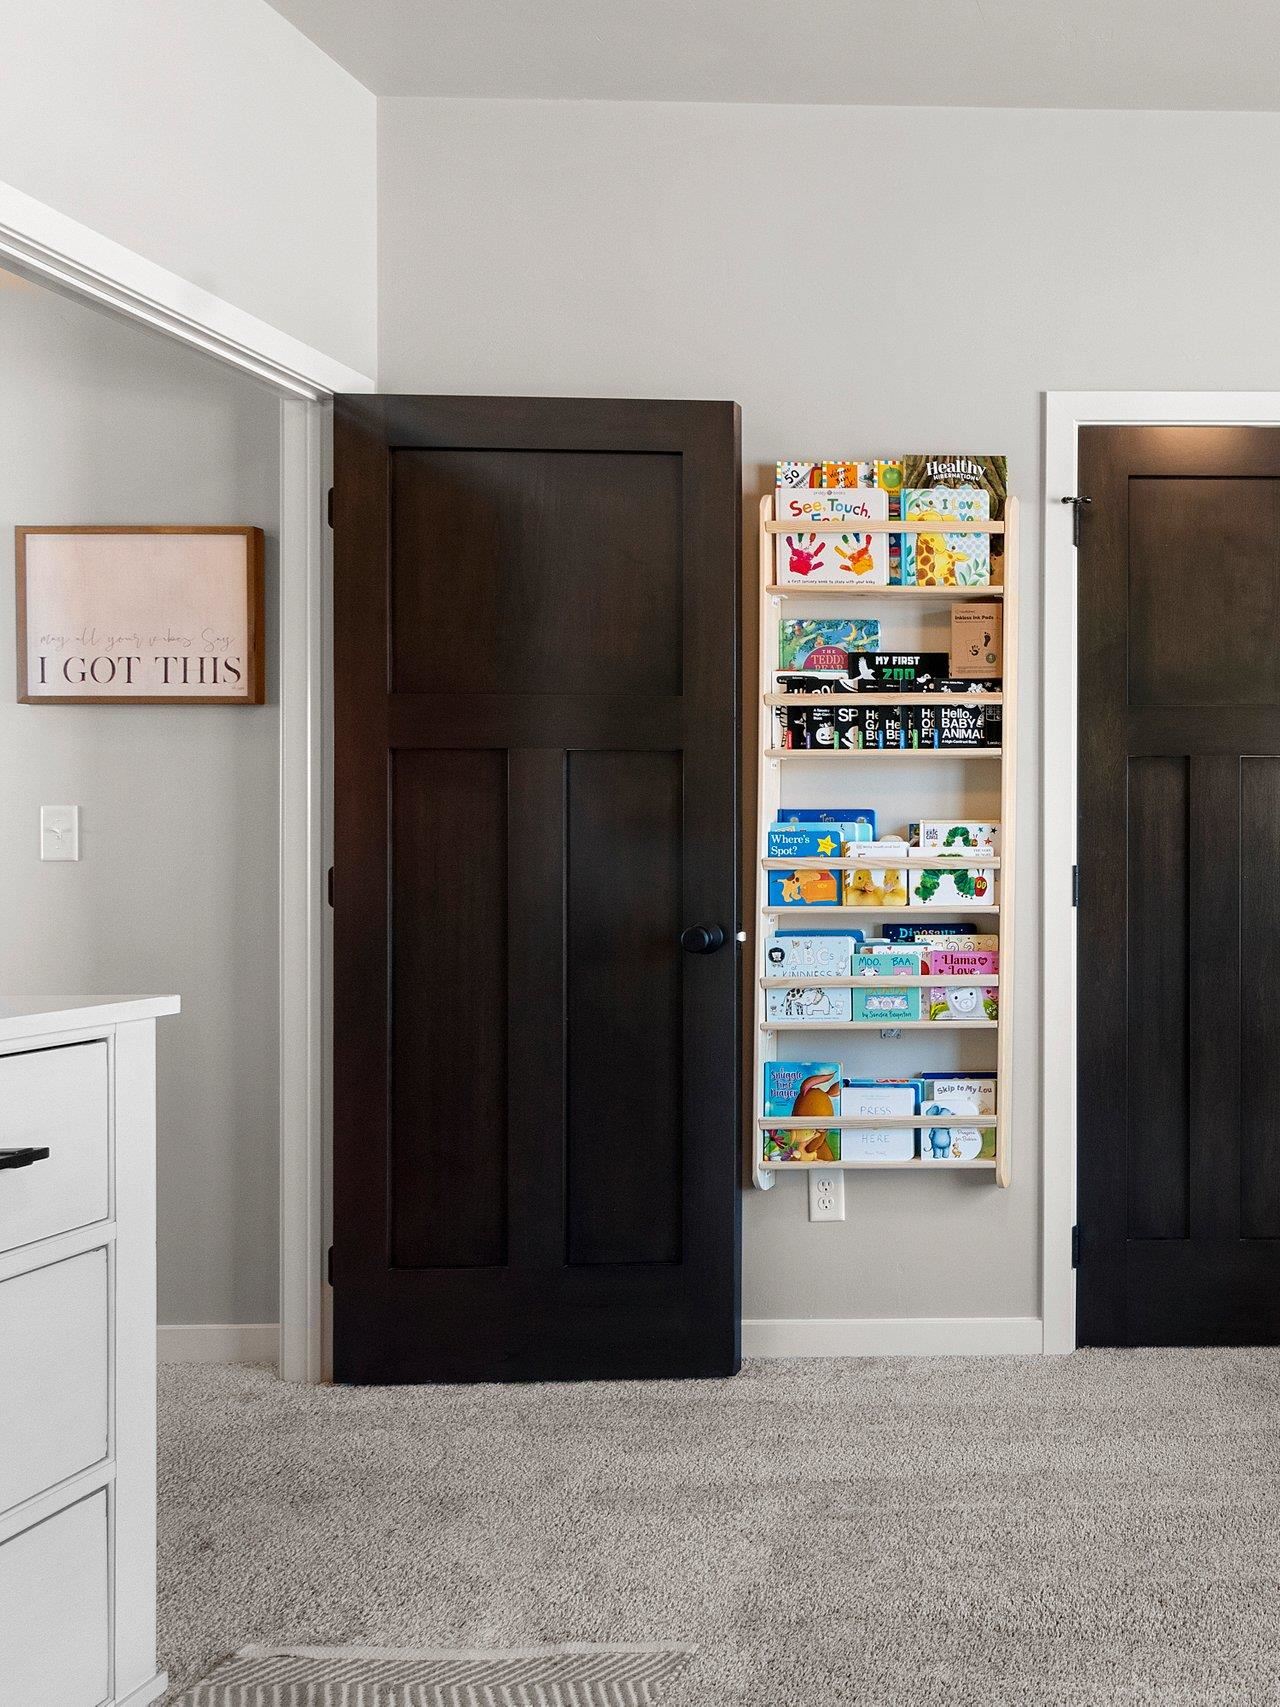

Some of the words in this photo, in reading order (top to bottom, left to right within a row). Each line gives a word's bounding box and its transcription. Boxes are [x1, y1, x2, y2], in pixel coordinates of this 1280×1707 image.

[926, 460, 986, 480] Healthy
[784, 469, 800, 484] 50
[827, 498, 871, 518] Touch,
[942, 499, 948, 510] I
[811, 655, 848, 665] TEDDY
[875, 656, 889, 665] MY
[892, 656, 920, 665] FIRST
[39, 656, 48, 684] I
[63, 656, 141, 684] GOT
[154, 656, 241, 684] THIS
[882, 668, 915, 680] ZOO
[838, 708, 859, 722] SP
[941, 708, 973, 720] Hello,
[941, 718, 975, 728] BABY
[942, 729, 985, 739] ANIMAL
[771, 834, 810, 844] Where's
[771, 846, 798, 857] Spot?
[942, 954, 977, 965] Llama
[948, 965, 976, 975] Love
[937, 1084, 955, 1094] Skip
[965, 1085, 976, 1094] My
[978, 1086, 992, 1094] Lou
[860, 1106, 892, 1115] PRESS
[862, 1134, 890, 1143] HERE
